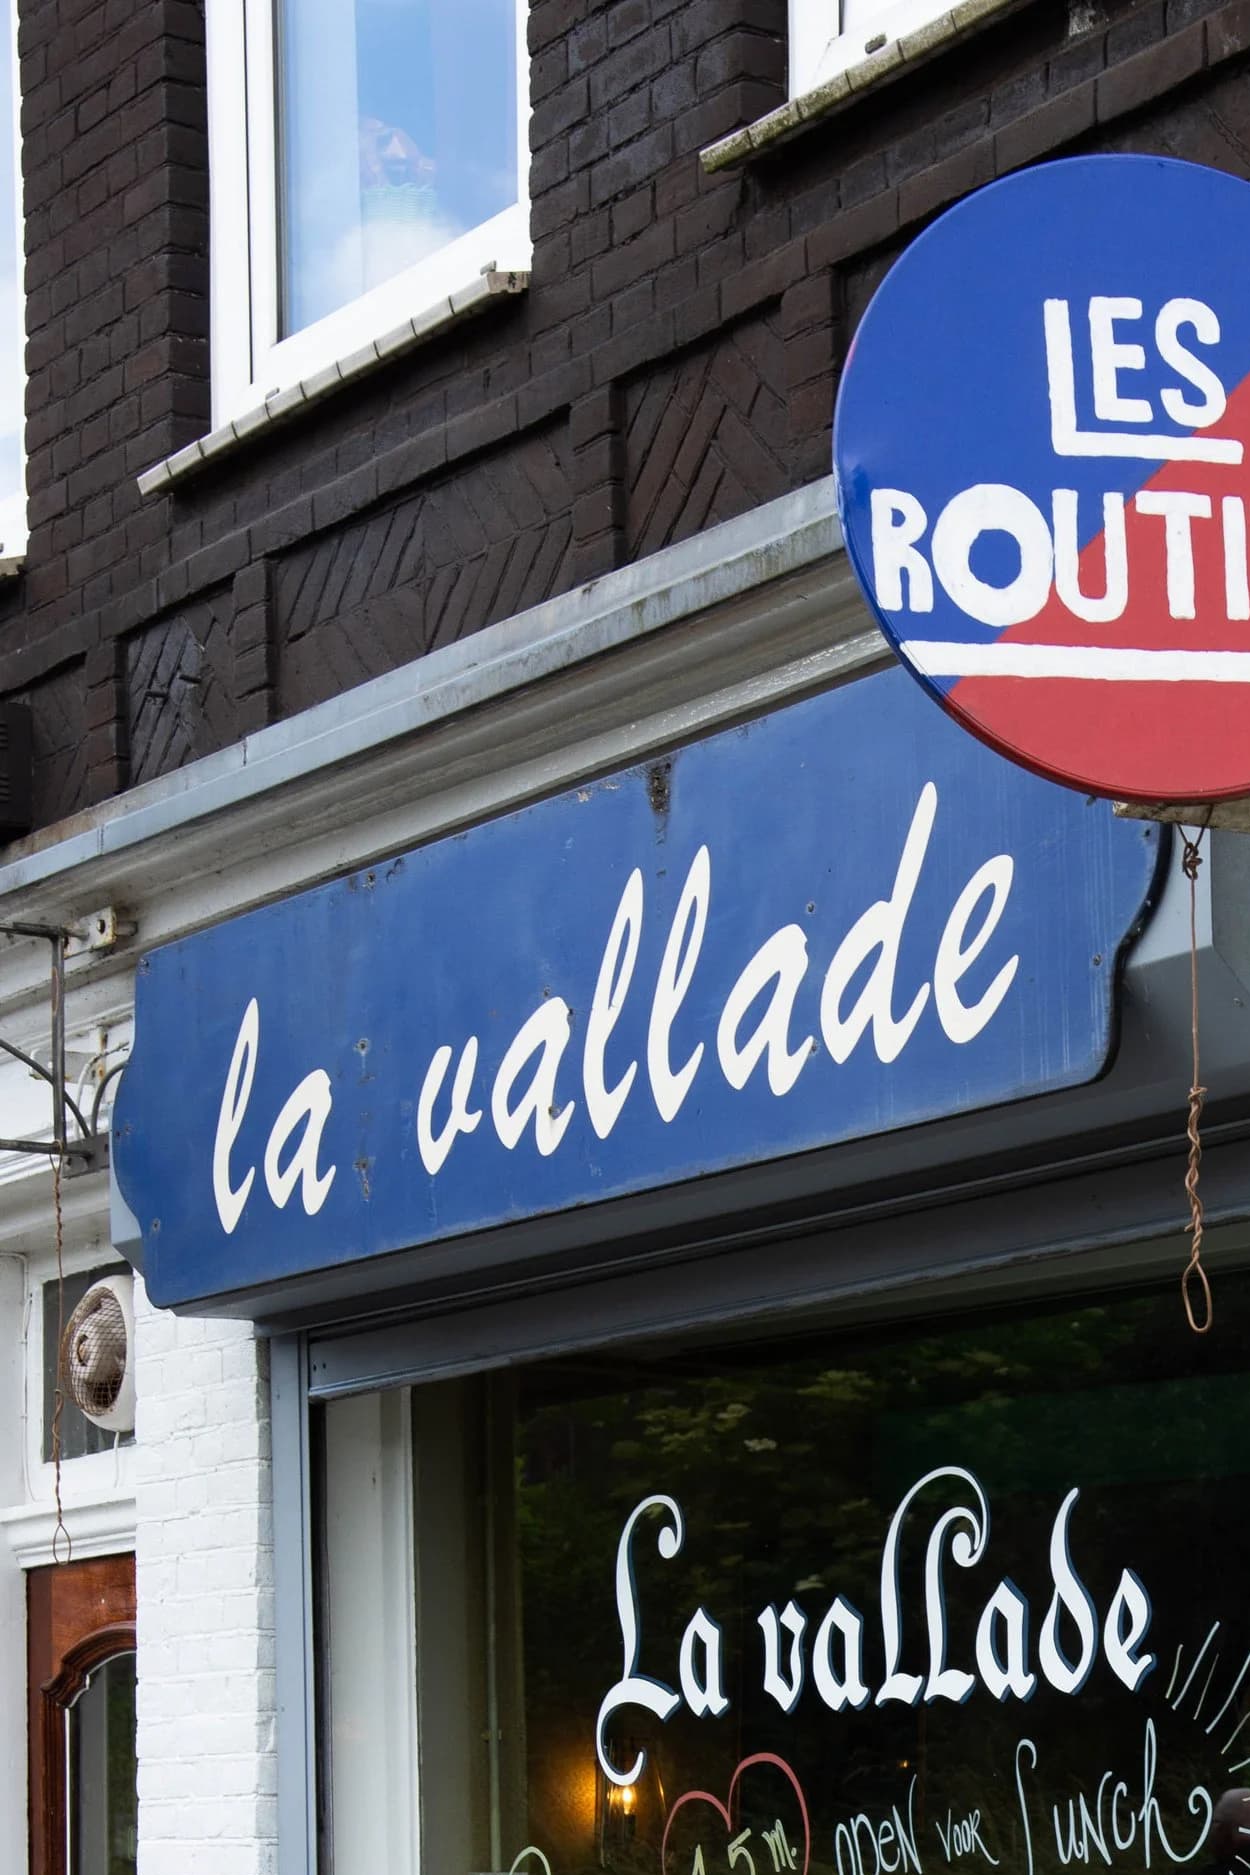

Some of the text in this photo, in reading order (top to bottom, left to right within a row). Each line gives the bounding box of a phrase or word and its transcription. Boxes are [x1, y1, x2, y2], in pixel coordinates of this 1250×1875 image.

[1044, 296, 1243, 464] LES
[214, 781, 1019, 1234] la vallade
[597, 1494, 730, 1786] La
